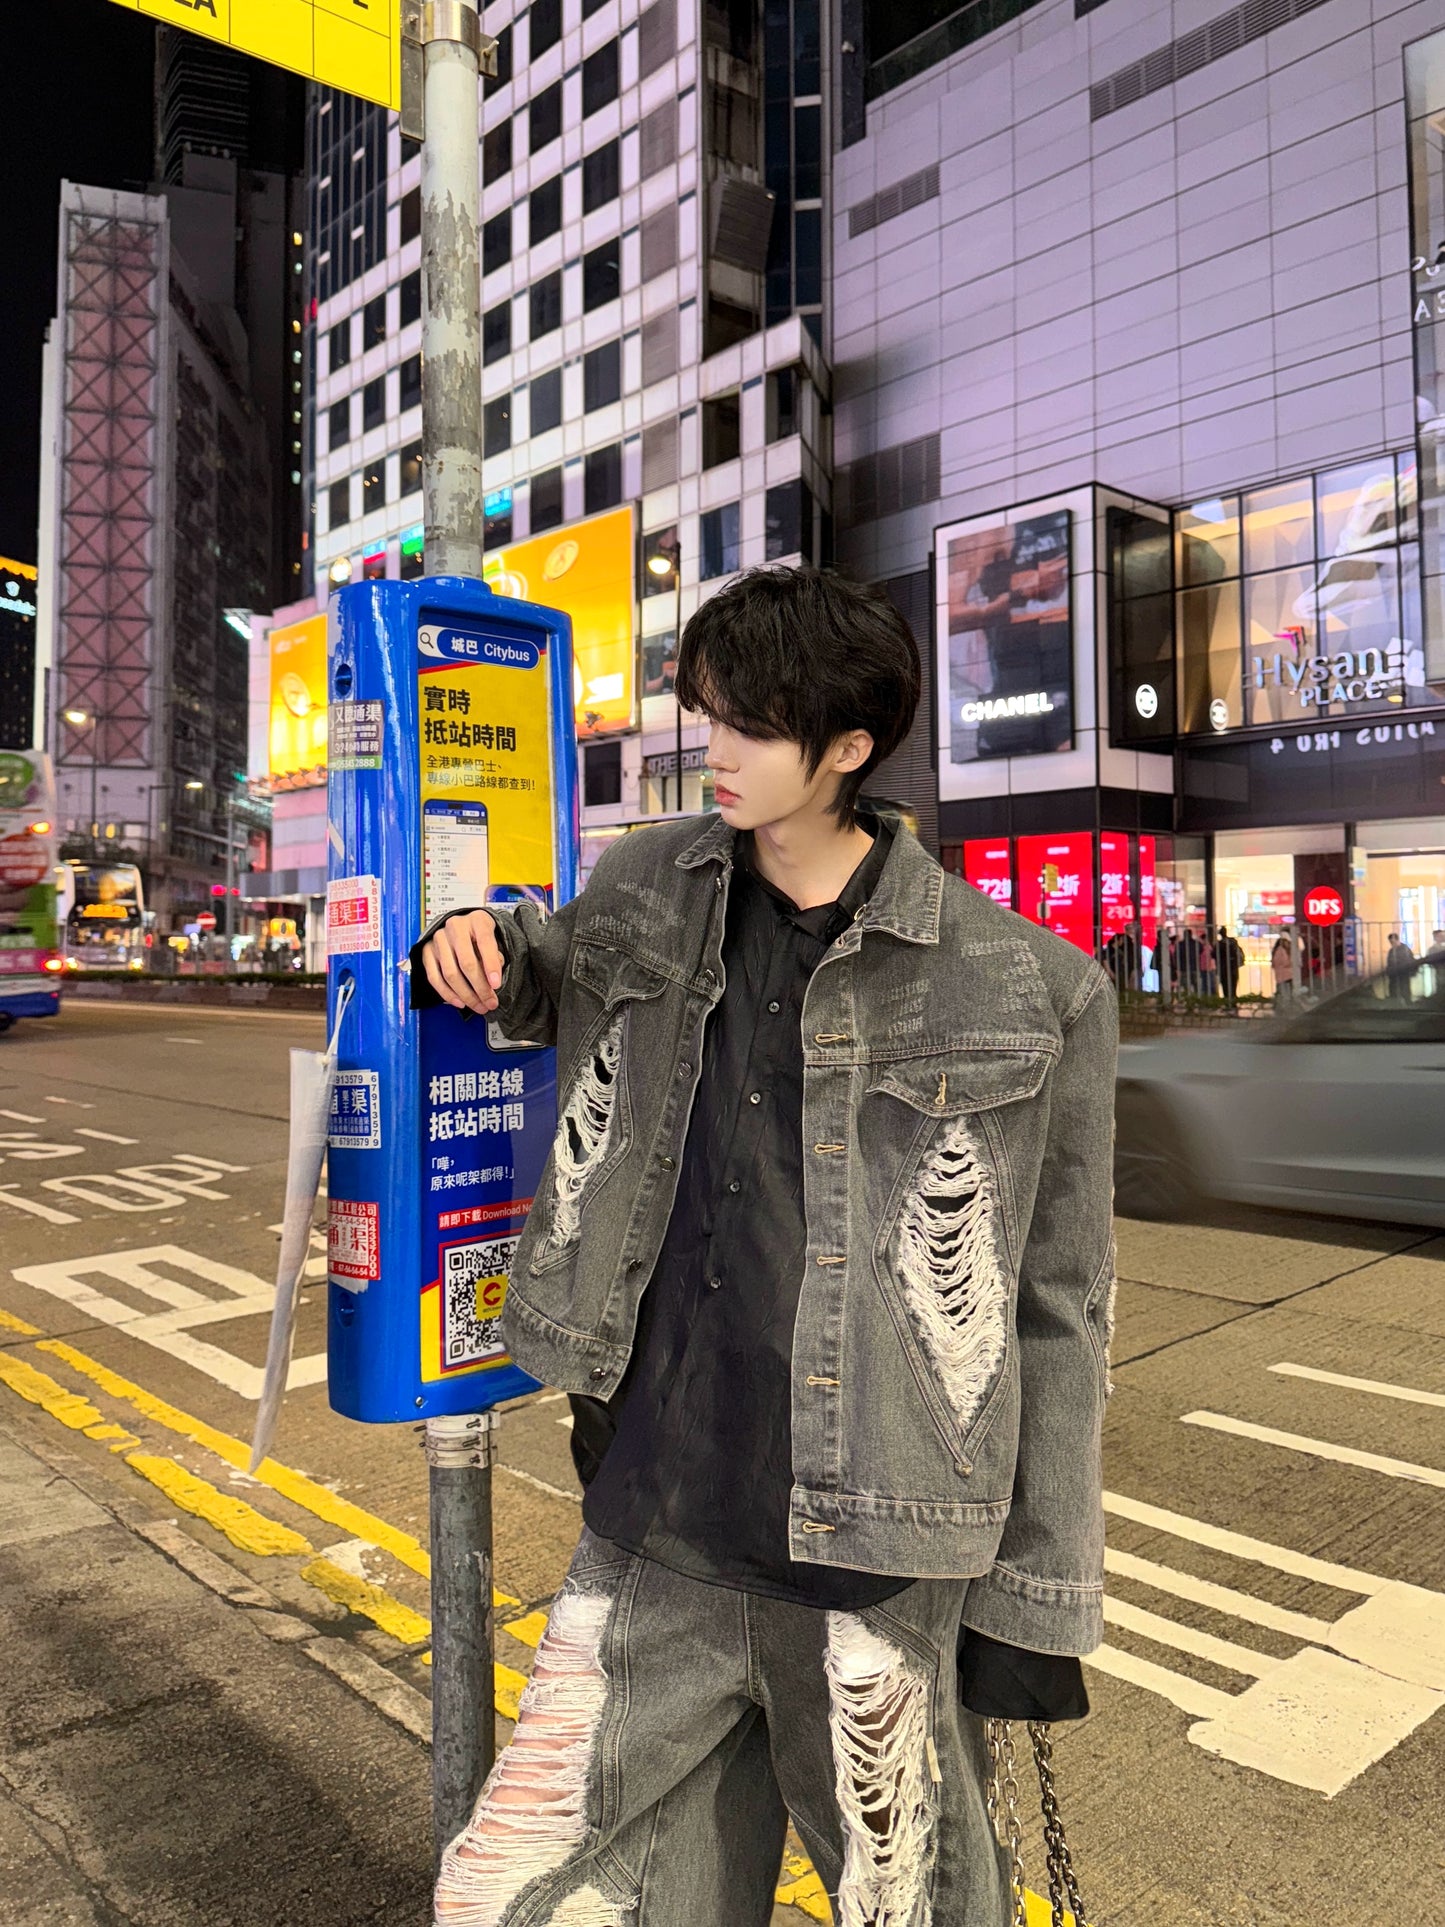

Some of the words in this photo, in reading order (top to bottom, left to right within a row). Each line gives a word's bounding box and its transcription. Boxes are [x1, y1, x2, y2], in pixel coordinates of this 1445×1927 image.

[451, 637, 479, 657] 城巴
[484, 641, 531, 663] Citybus
[1253, 647, 1383, 697] Hysan
[423, 686, 471, 715] 實時
[961, 691, 1054, 723] CHANEL
[1300, 680, 1384, 707] PLACE
[424, 718, 517, 751] 抵站時間
[426, 755, 502, 773] 全港專營巴士、
[1308, 899, 1342, 916] DFS
[335, 1075, 363, 1085] 913579
[428, 1067, 525, 1107] 相關路線
[371, 1075, 380, 1147] 67913579
[429, 1103, 525, 1142] 抵站時間
[339, 1137, 370, 1147] 67913579
[439, 1208, 482, 1228] 請即下載
[482, 1205, 522, 1221] Download
[522, 1203, 533, 1216] No
